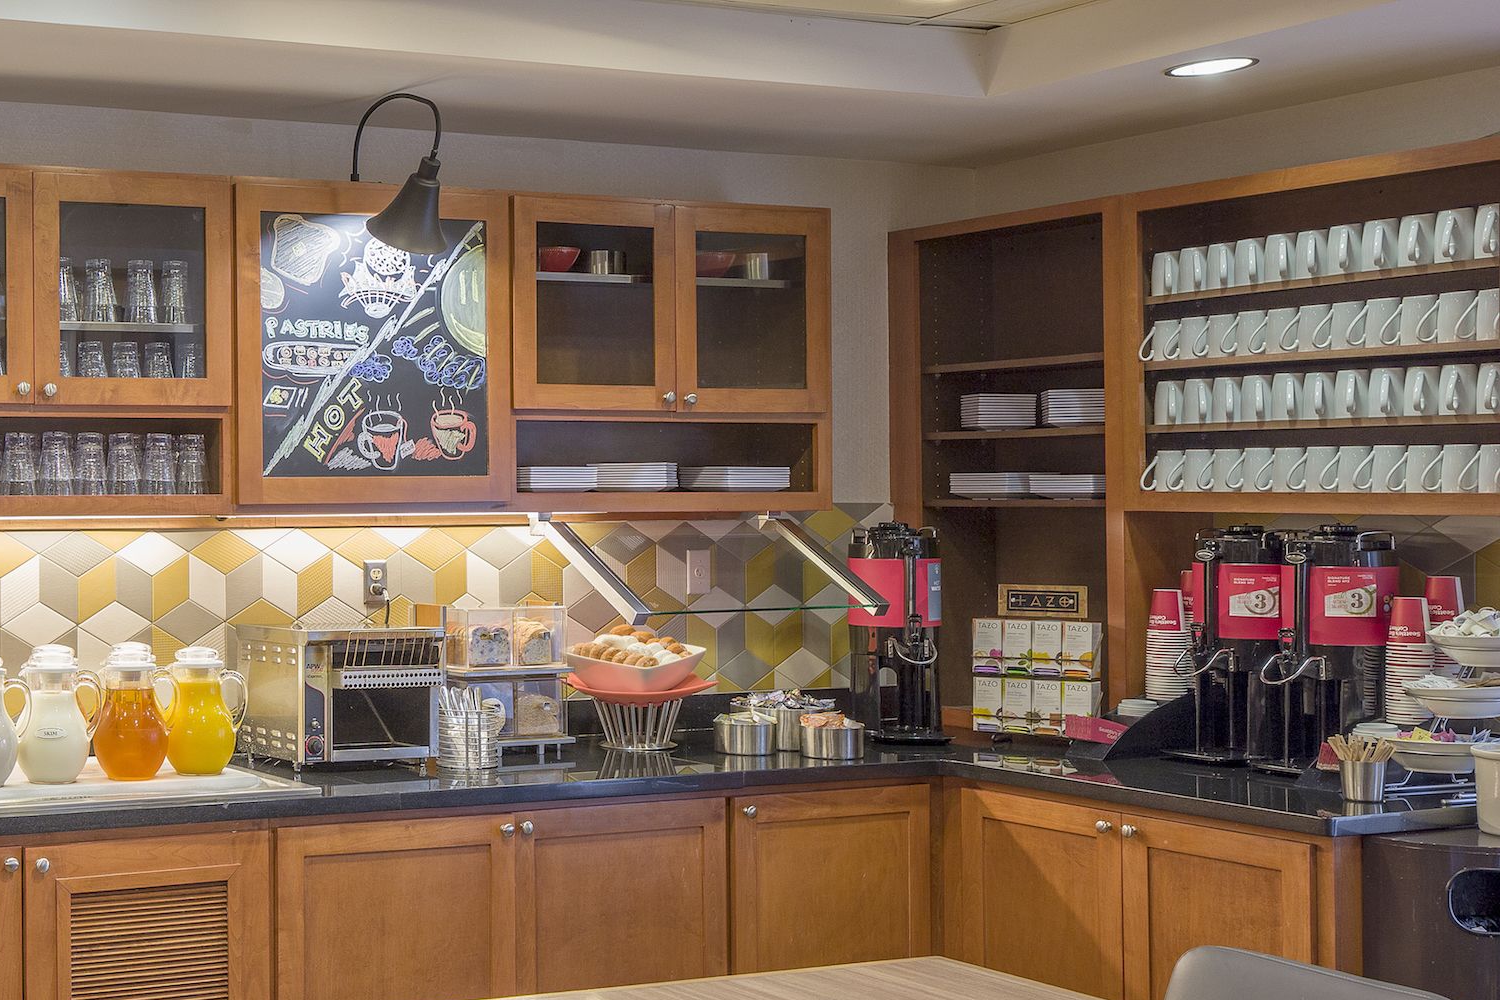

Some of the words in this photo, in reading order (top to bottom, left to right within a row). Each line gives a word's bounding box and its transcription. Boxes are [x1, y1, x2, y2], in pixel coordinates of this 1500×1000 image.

[264, 316, 370, 344] PASTRIES
[302, 377, 365, 463] HOT
[1254, 594, 1266, 609] 3
[1350, 592, 1364, 608] 3
[978, 680, 998, 688] TAZO
[1007, 681, 1028, 689] TAZO
[1036, 682, 1058, 691] TAZO
[1067, 684, 1088, 692] TAZO
